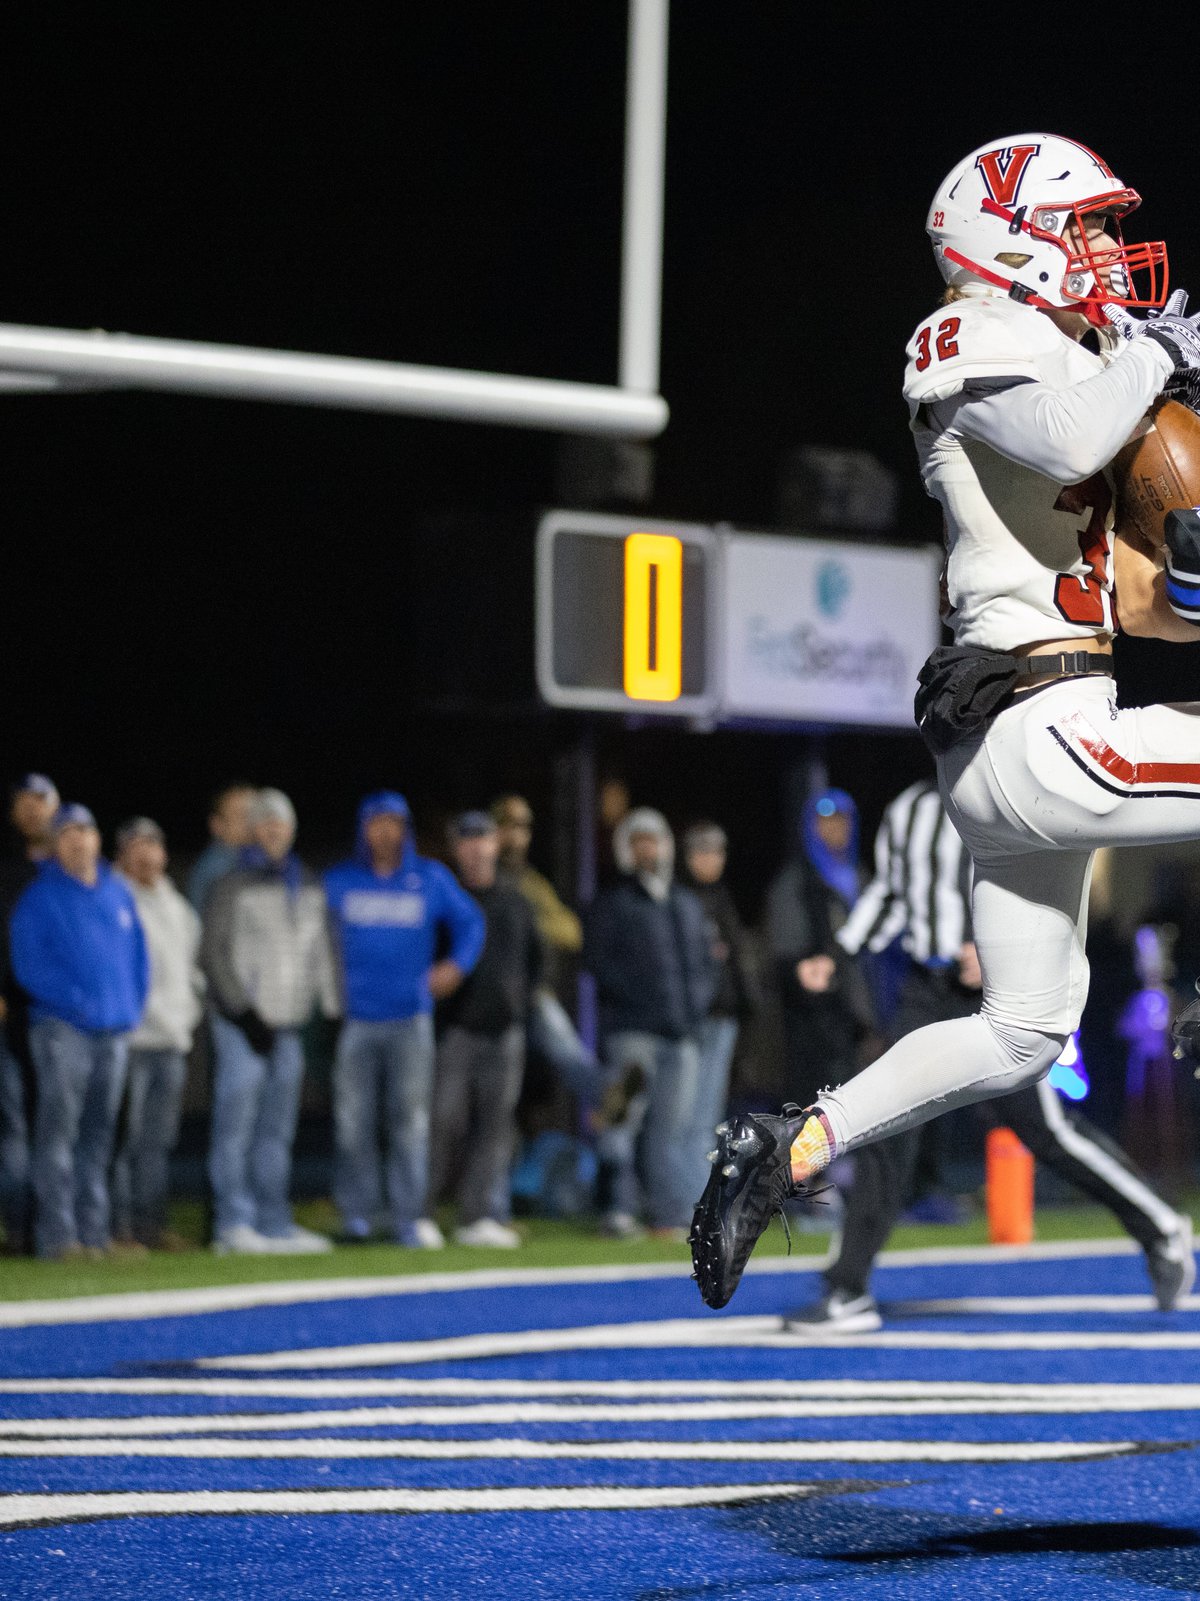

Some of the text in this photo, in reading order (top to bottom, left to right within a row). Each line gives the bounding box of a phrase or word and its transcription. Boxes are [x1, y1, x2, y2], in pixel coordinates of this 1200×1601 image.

[974, 144, 1041, 207] V
[932, 211, 945, 227] 32
[914, 316, 962, 373] 32
[1140, 473, 1165, 511] GST
[1157, 471, 1174, 500] NCAA
[1052, 470, 1121, 634] 3
[624, 532, 683, 702] 0
